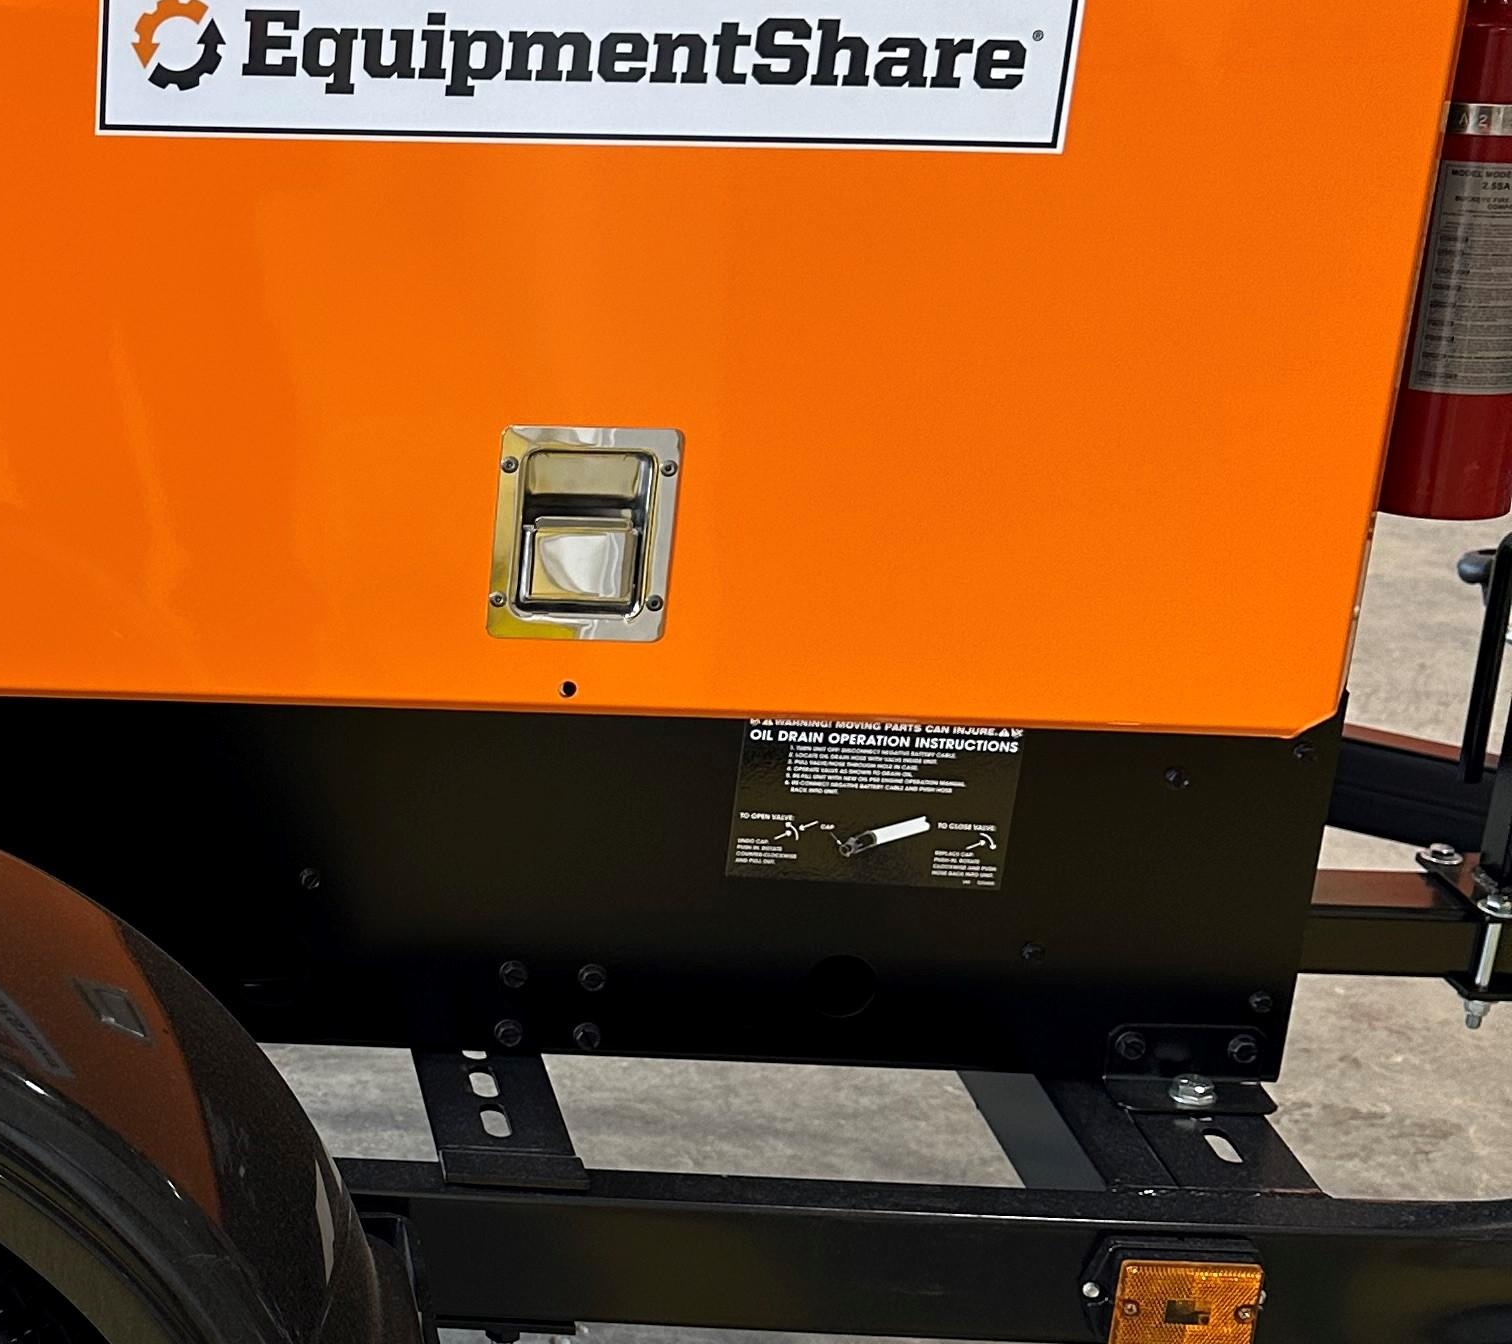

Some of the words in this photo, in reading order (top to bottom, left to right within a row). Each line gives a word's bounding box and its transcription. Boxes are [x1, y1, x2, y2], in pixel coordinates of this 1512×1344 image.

[884, 723, 922, 733] PARTS
[924, 725, 950, 734] CAN
[750, 729, 774, 741] OIL
[778, 730, 824, 743] DRAIN
[828, 732, 911, 747] OPERATION
[914, 737, 1019, 753] INSTRUCTIONS
